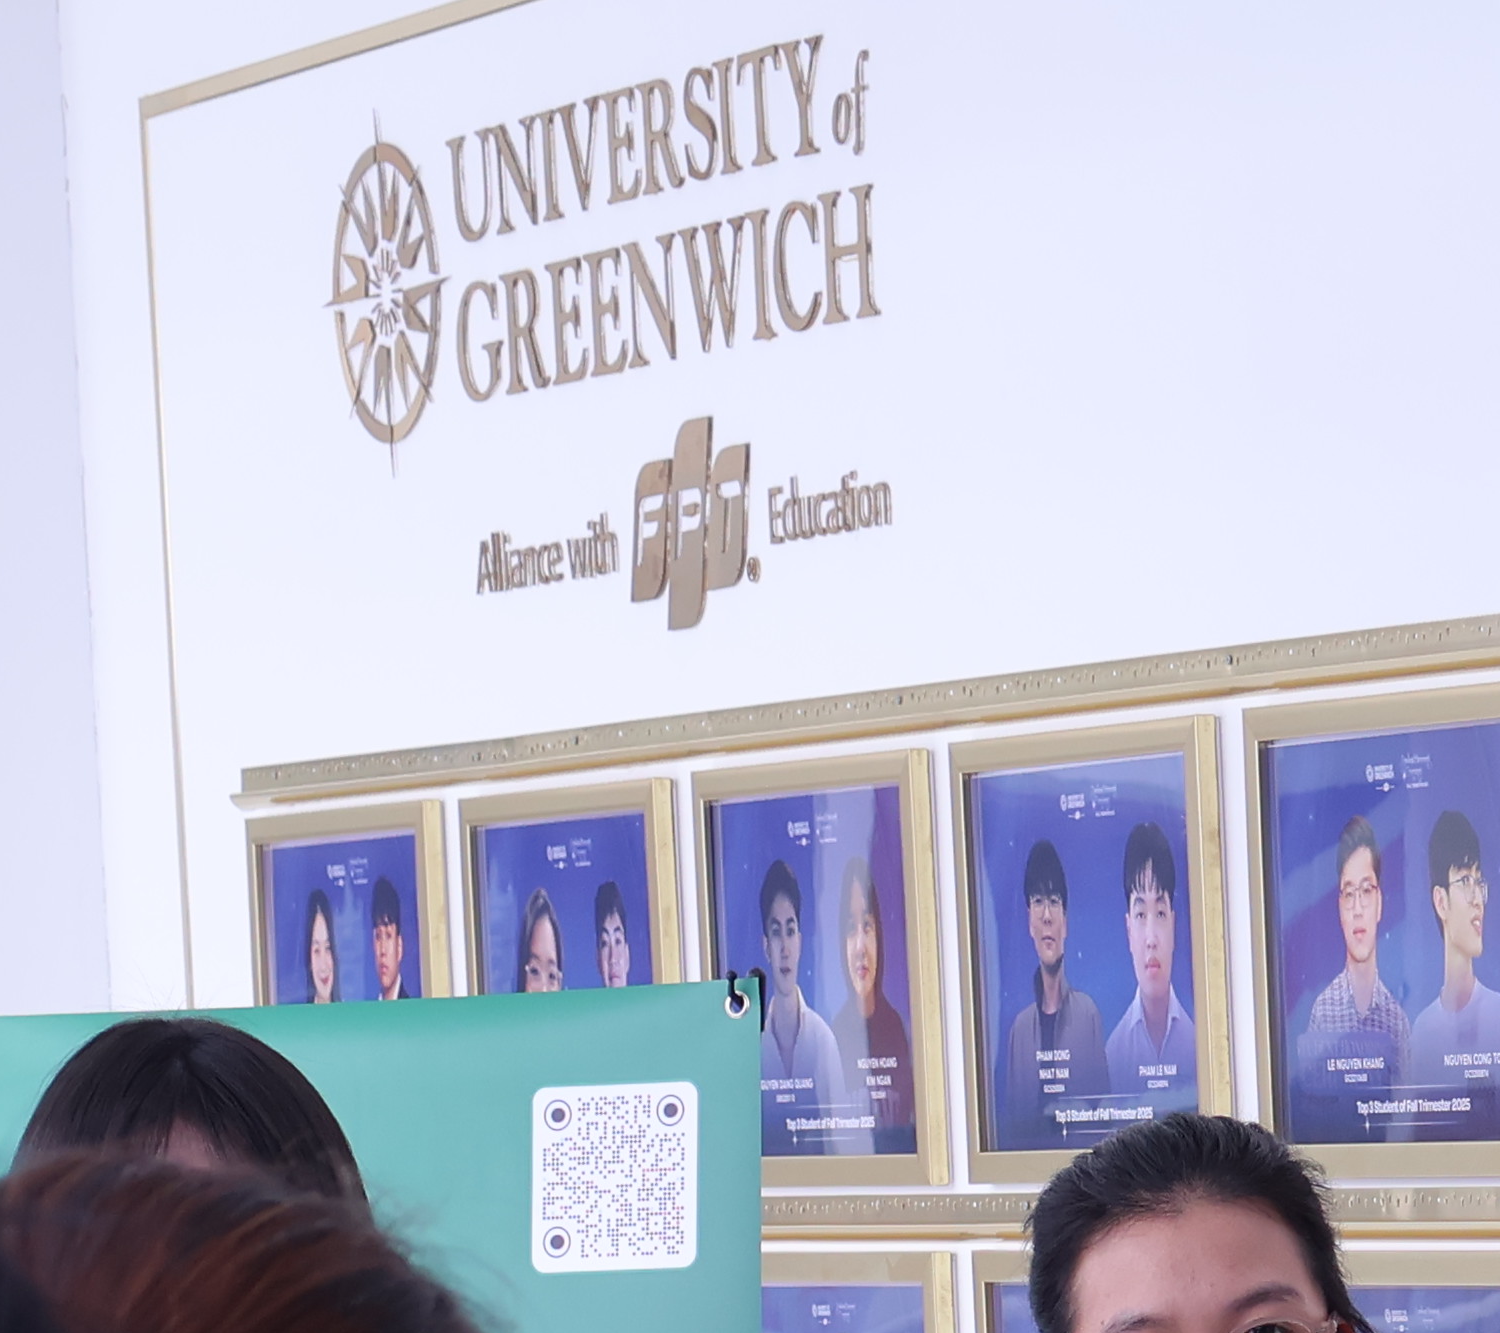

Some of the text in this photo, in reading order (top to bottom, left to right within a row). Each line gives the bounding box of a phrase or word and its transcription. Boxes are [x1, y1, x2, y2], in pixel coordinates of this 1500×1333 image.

[448, 35, 870, 243] UNIVERSITY of
[456, 184, 881, 403] GREENWICH
[477, 531, 564, 594] Alliance
[566, 512, 619, 580] with
[769, 471, 892, 545] Education
